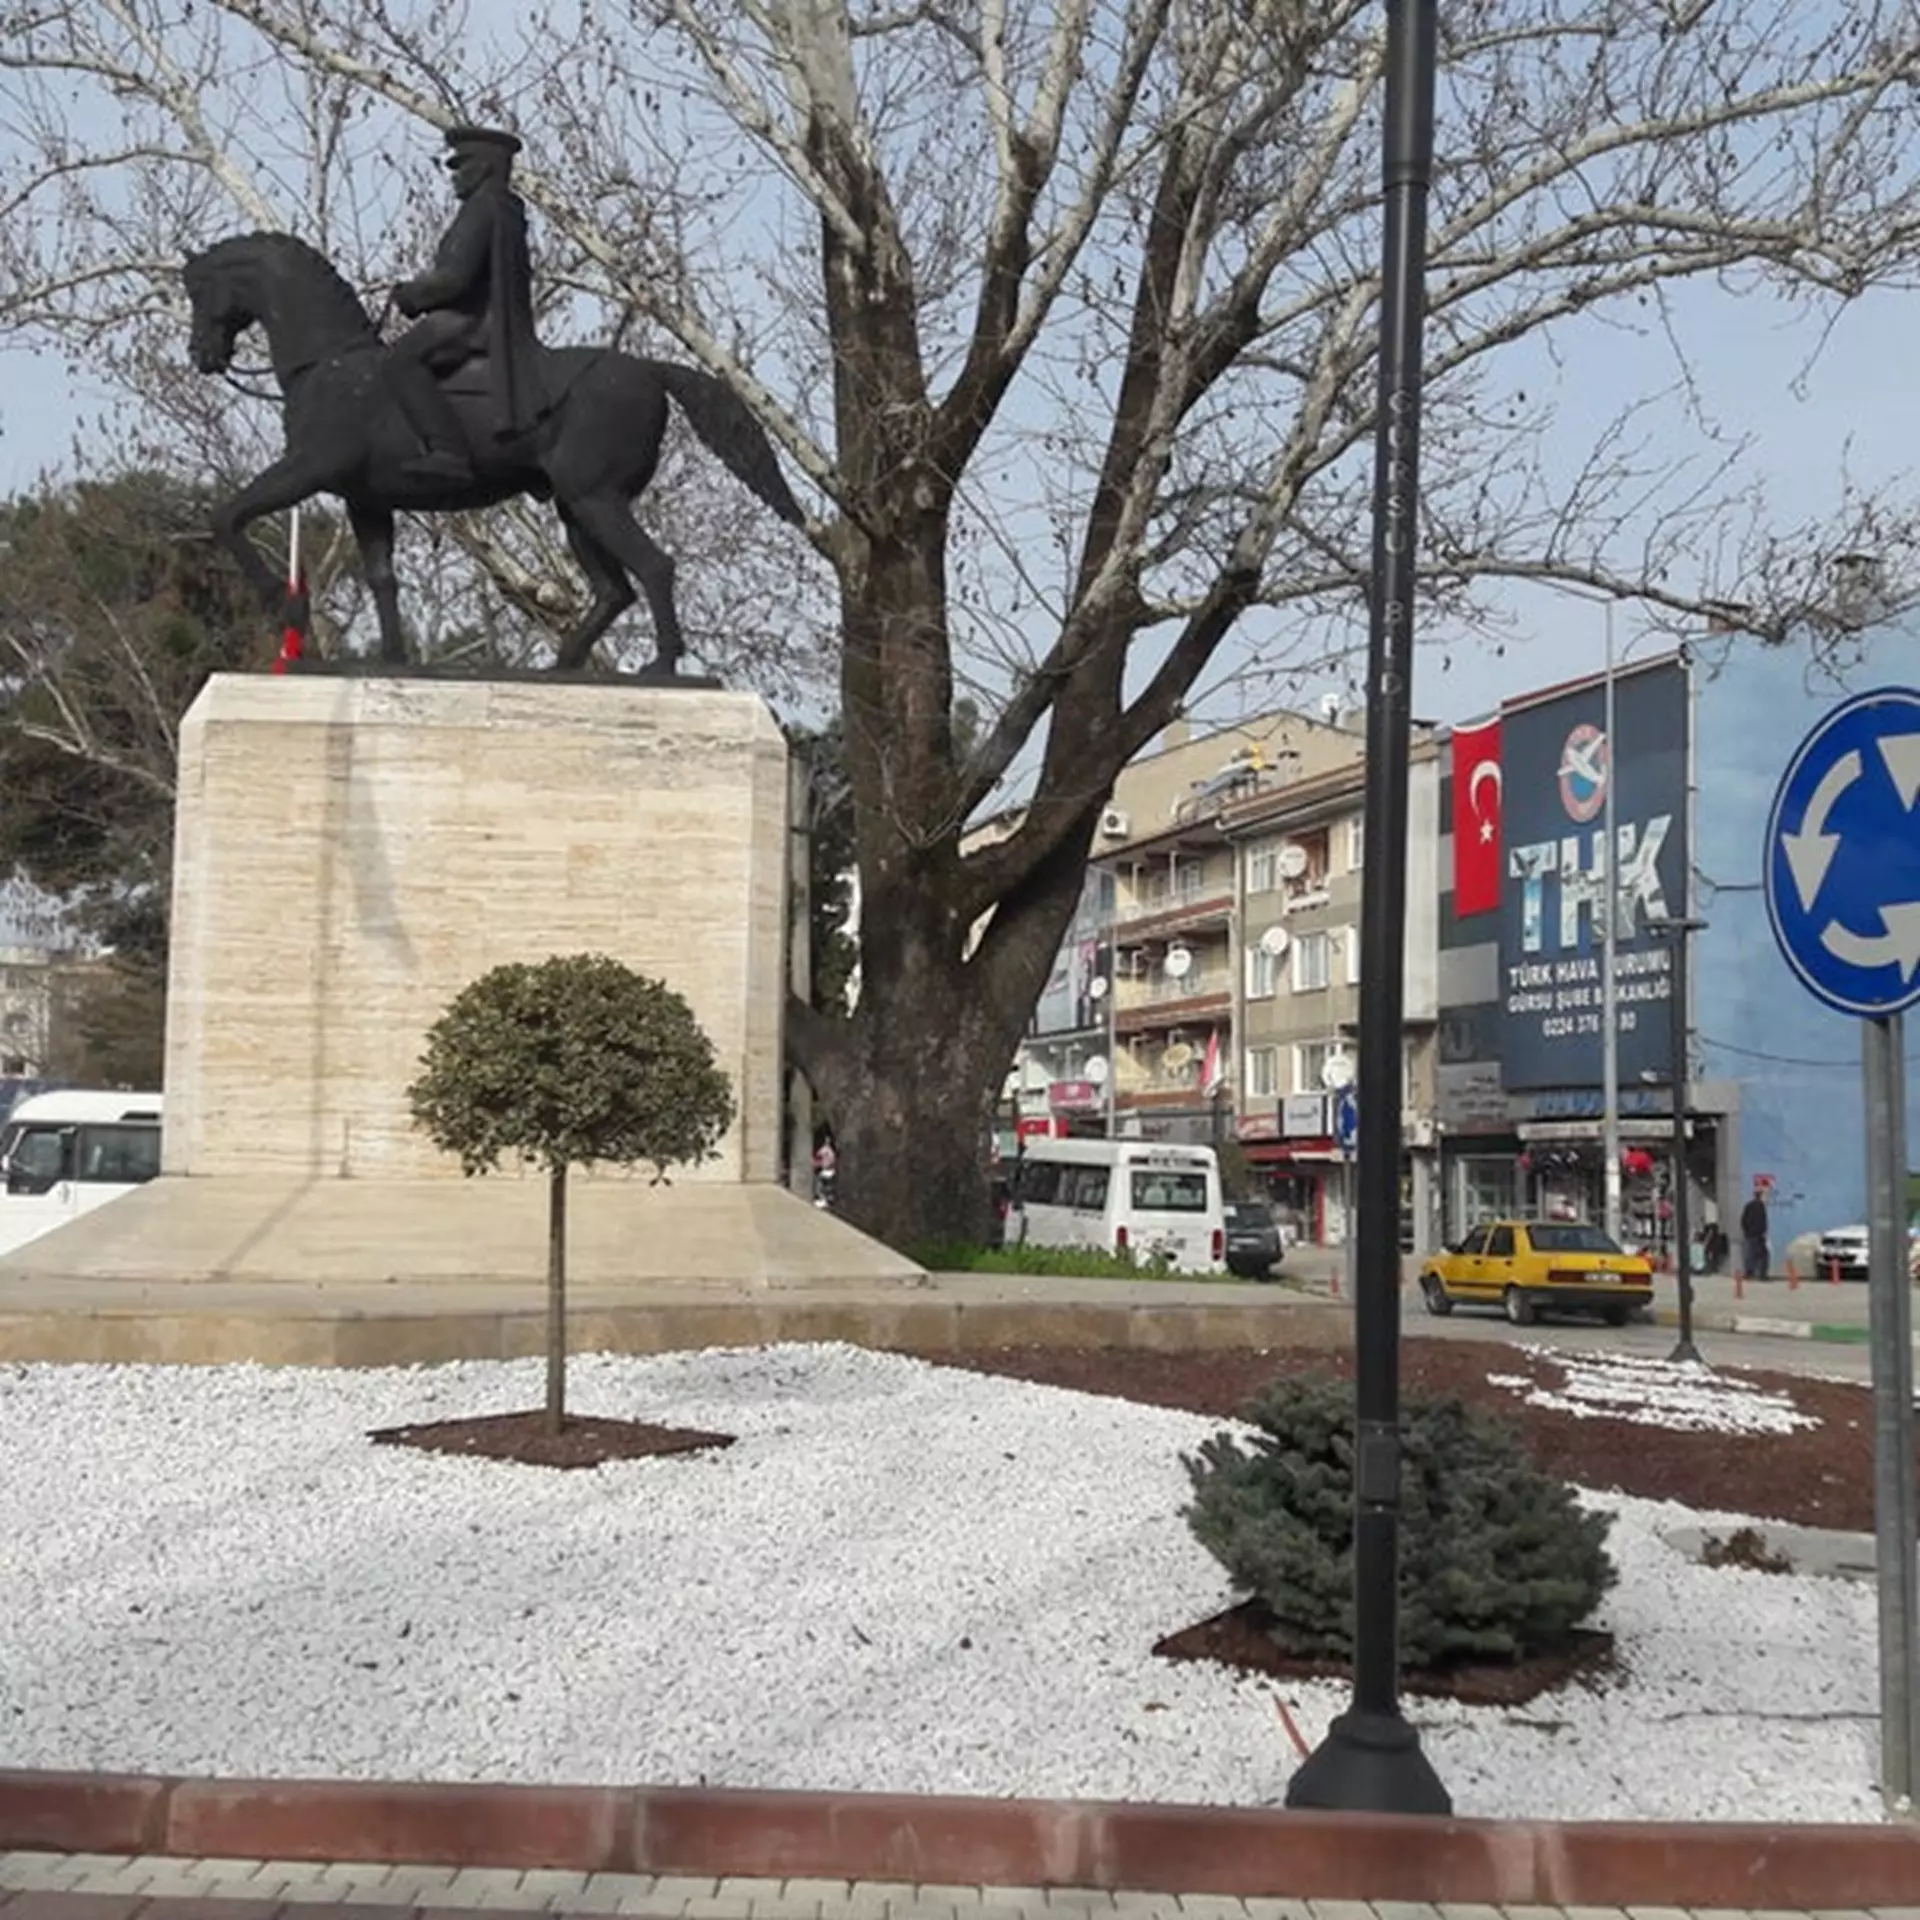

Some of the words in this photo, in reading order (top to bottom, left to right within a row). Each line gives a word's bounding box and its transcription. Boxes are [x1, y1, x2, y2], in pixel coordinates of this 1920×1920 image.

[1508, 814, 1672, 952] THK
[1508, 961, 1553, 988] TÜRK
[1555, 957, 1599, 983] HAVA
[1613, 948, 1671, 978] URUMU
